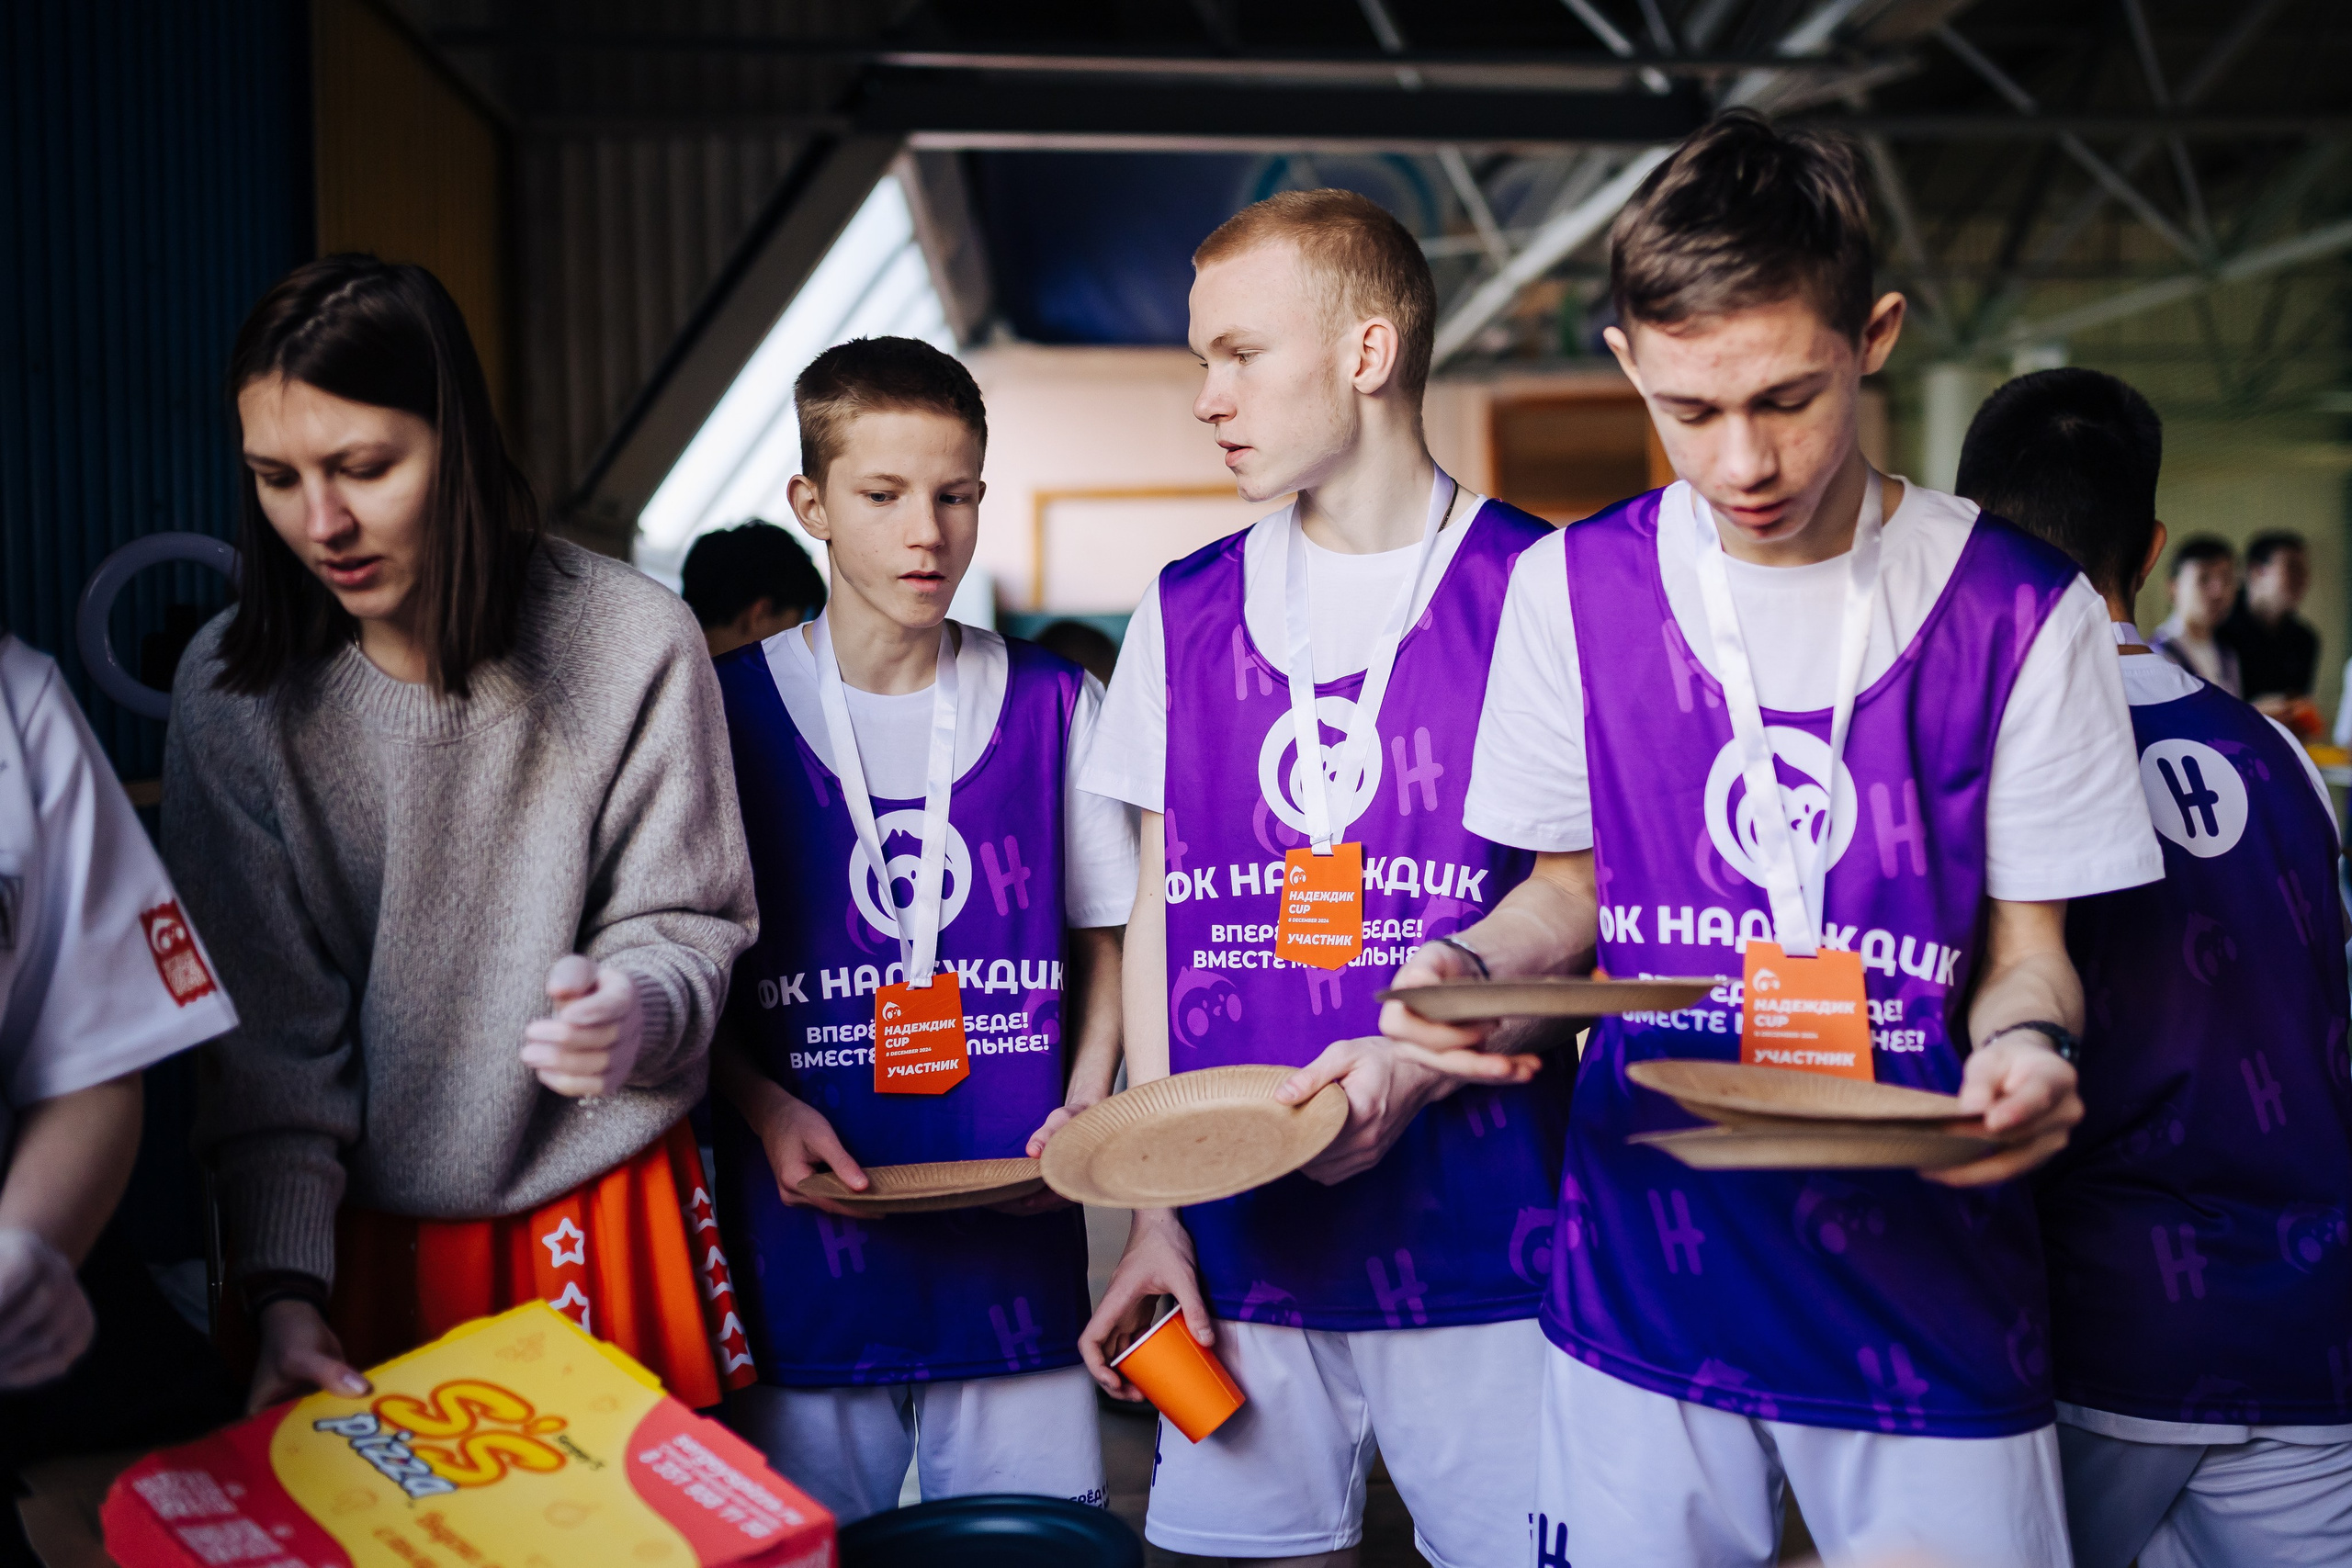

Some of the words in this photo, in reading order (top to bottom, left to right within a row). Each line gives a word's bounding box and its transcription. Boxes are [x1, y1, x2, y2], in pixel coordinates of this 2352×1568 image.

[1165, 866, 1219, 904] ФК
[1229, 856, 1488, 902] НАЖДИК
[1288, 890, 1355, 903] НАДЕЖДИК
[1288, 904, 1311, 914] CUP
[1287, 933, 1353, 946] УЧАСТНИК
[757, 972, 809, 1010] ФК
[1752, 998, 1856, 1016] НАДЕЖДИК
[884, 1019, 956, 1036] НАДЕЖДИК
[1753, 1013, 1790, 1028] CUP
[885, 1037, 910, 1049] CUP
[890, 1048, 919, 1056] DECEMBER
[1754, 1049, 1856, 1066] УЧАСТНИК
[887, 1058, 960, 1078] УЧАСТНИК
[313, 1413, 458, 1499] pizza
